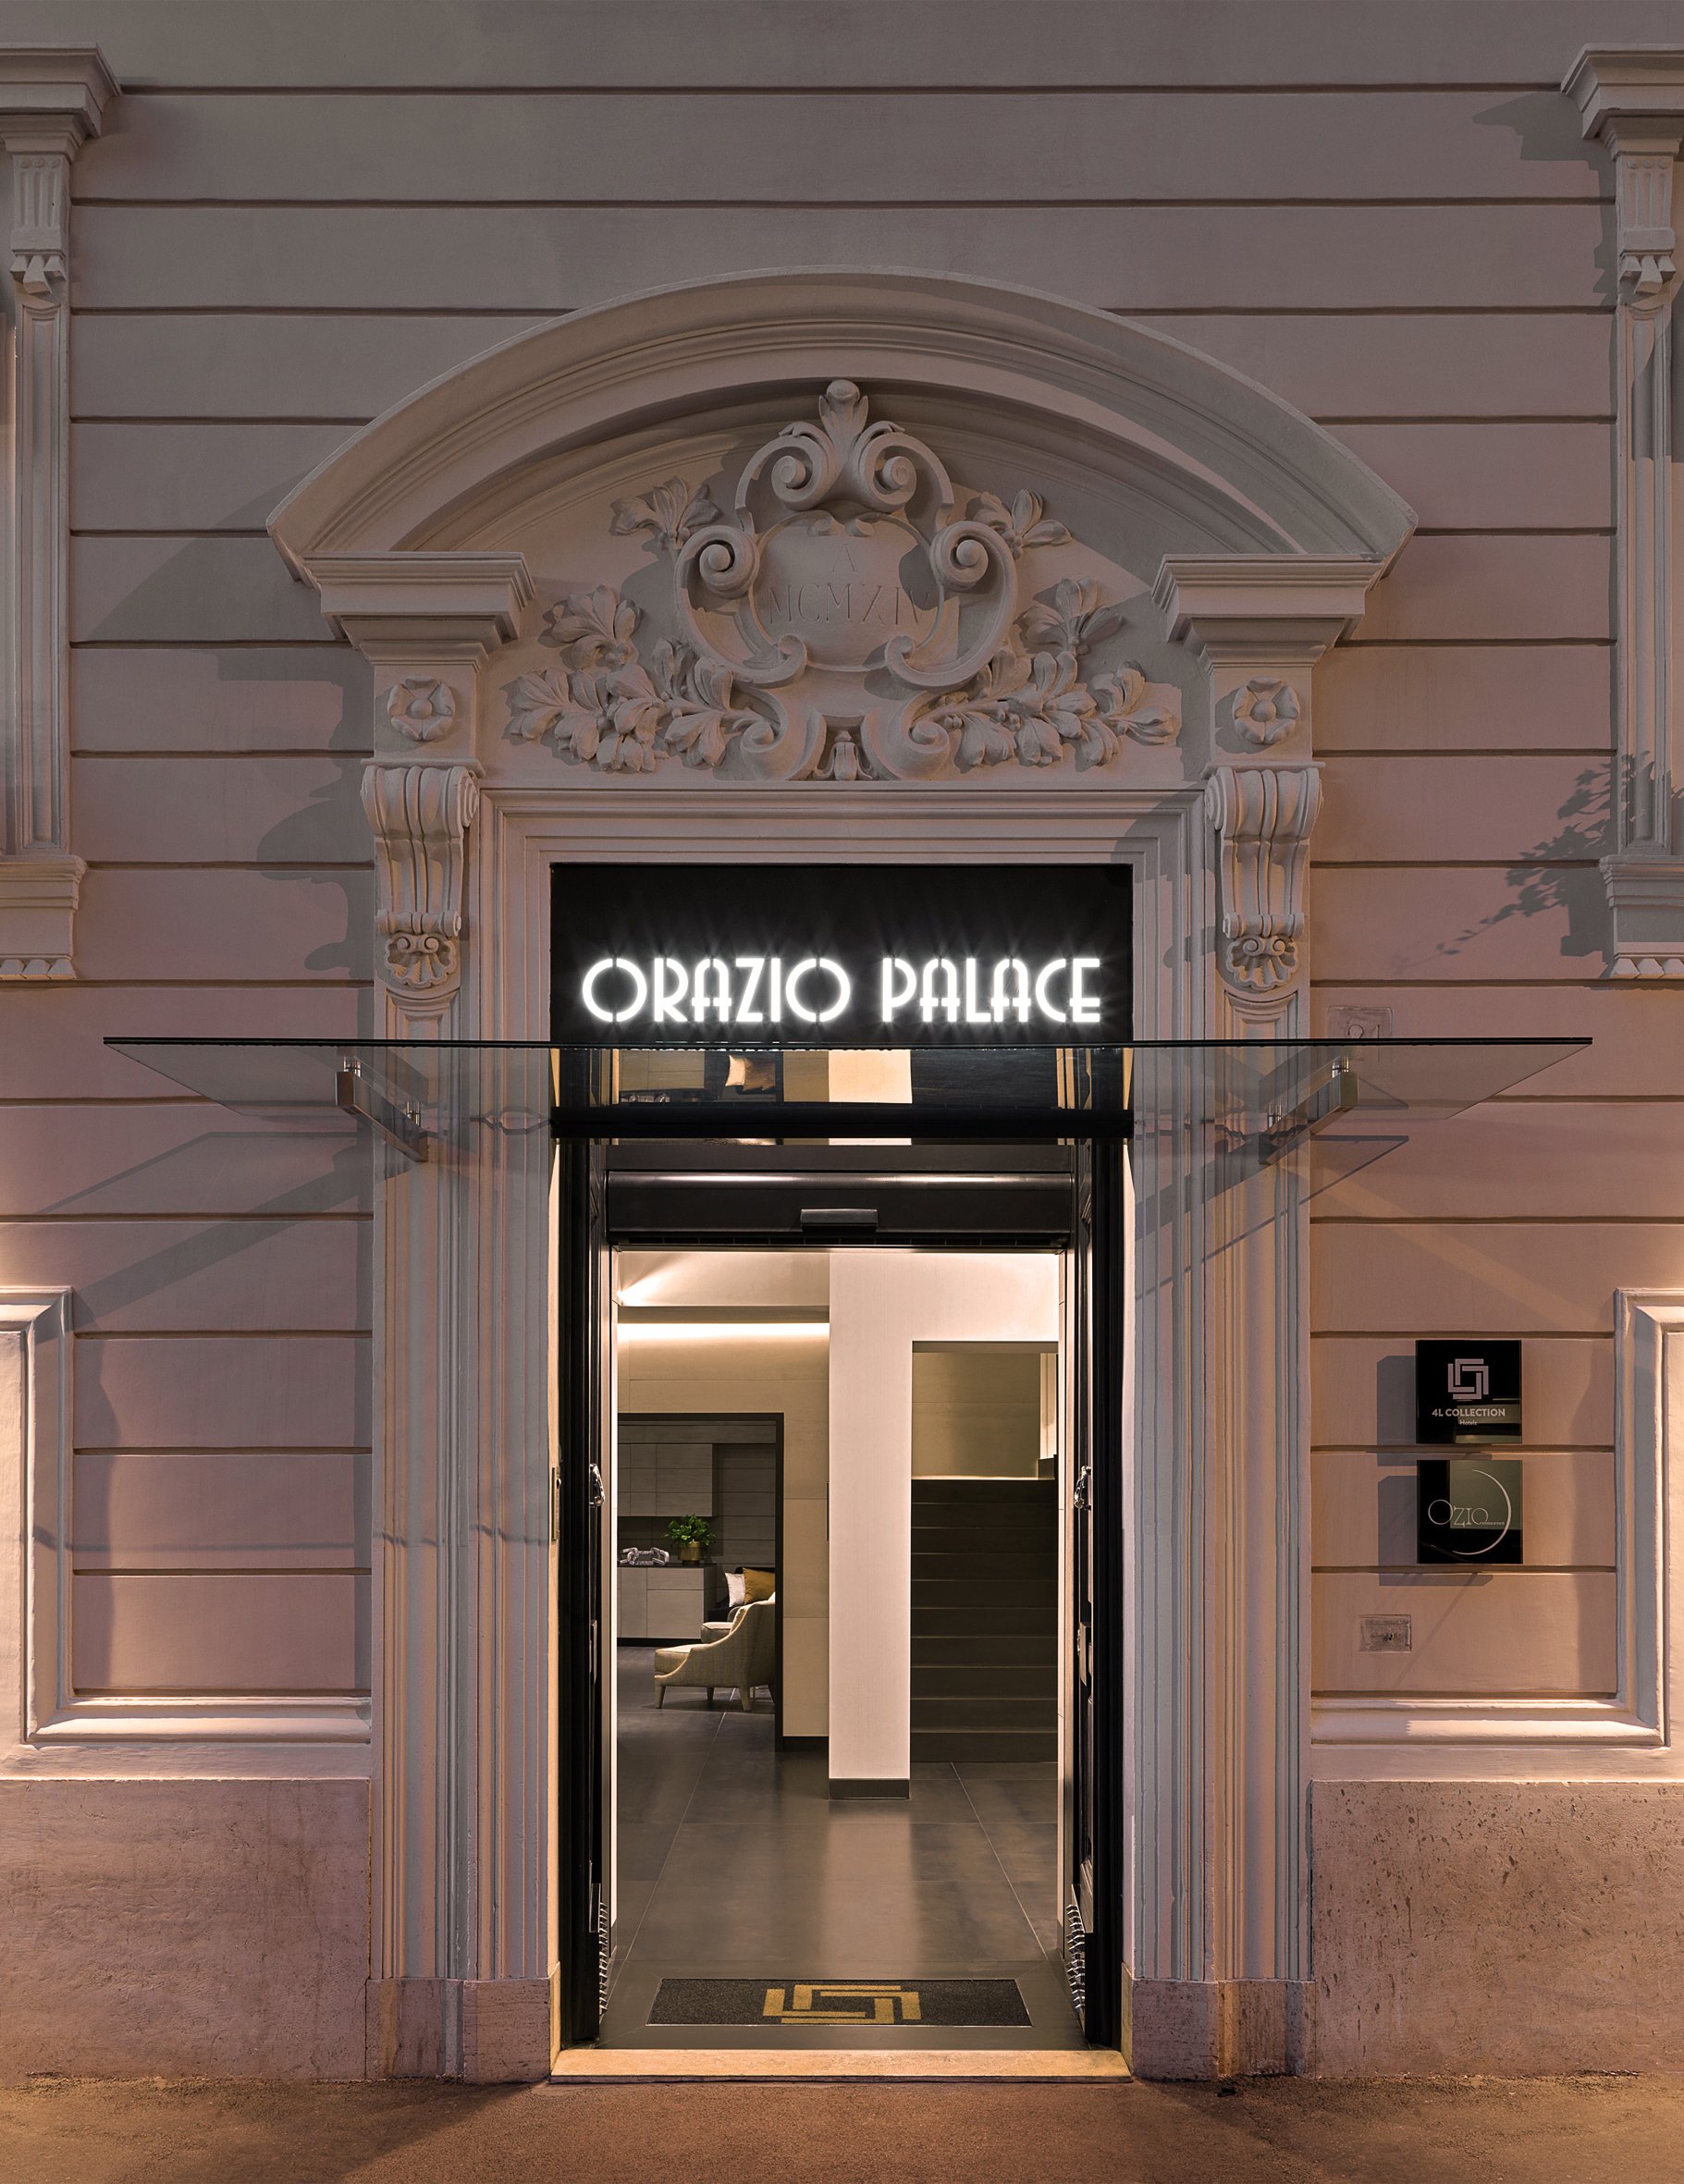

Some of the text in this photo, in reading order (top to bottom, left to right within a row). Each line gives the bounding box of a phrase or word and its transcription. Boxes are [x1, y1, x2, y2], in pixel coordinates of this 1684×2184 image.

[768, 584, 930, 625] MCMXIV
[582, 956, 1100, 1023] ORAZIO PALACE
[1431, 1407, 1506, 1417] 4L COLLECTION
